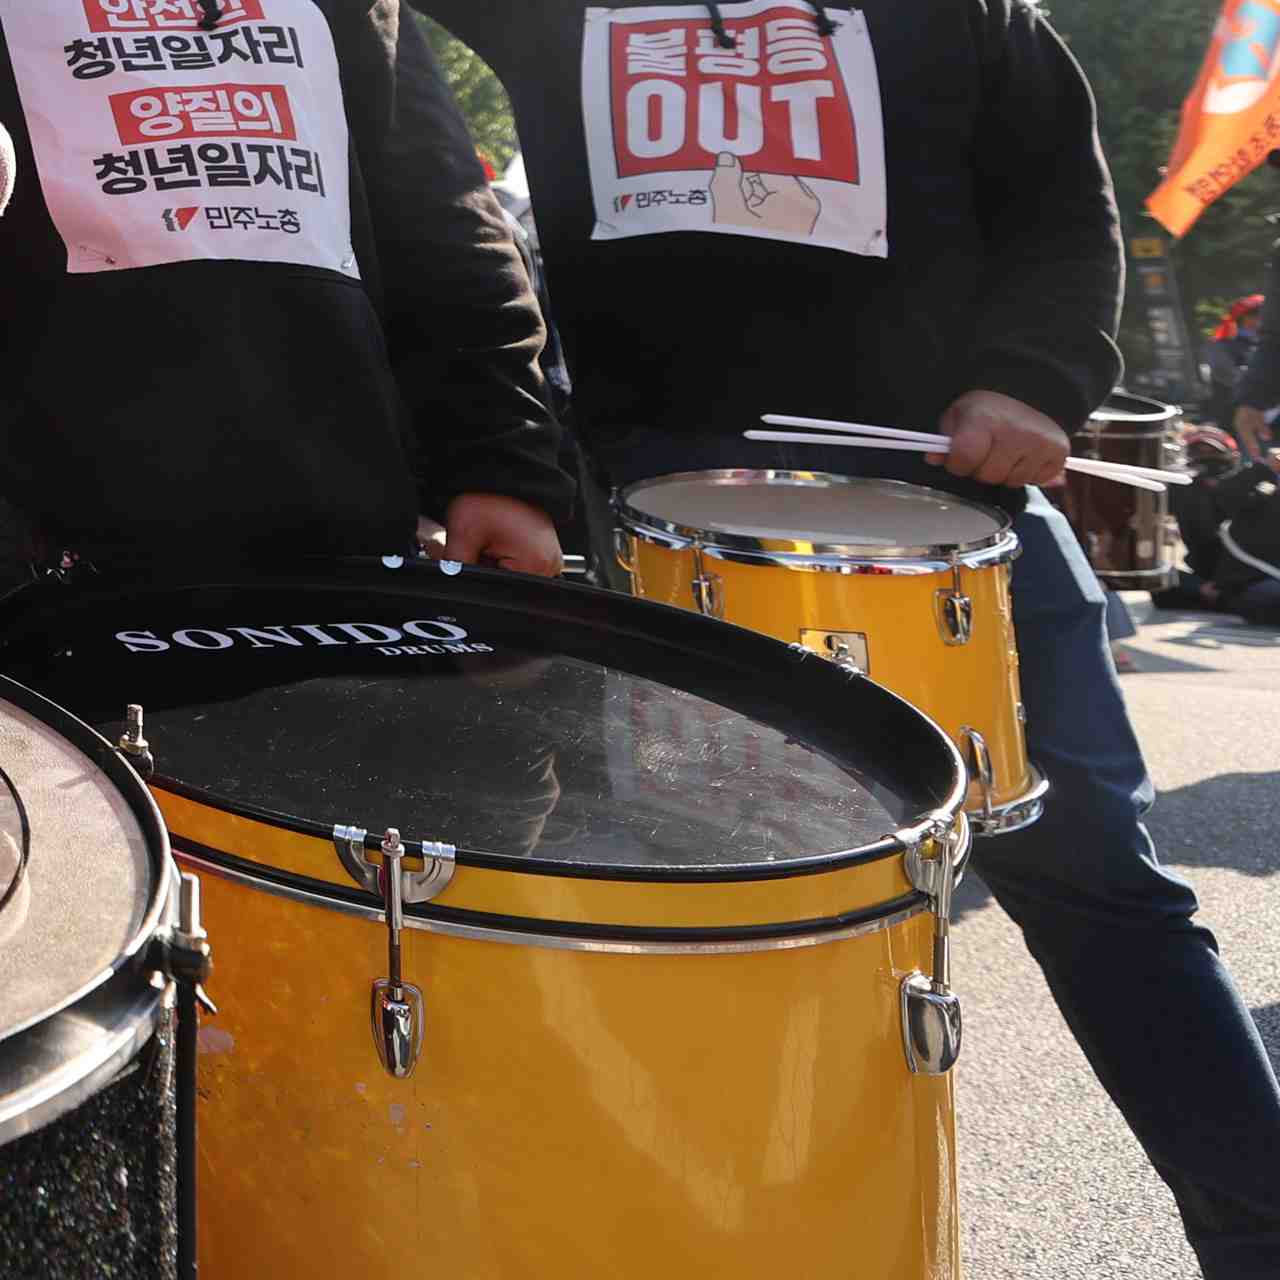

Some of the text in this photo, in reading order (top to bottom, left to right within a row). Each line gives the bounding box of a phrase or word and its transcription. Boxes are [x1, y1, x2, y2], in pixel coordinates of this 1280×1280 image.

[63, 25, 304, 80] 청년일자리
[626, 18, 827, 77] 불평등
[129, 89, 284, 137] 양질의
[626, 79, 836, 161] OUT
[93, 142, 327, 198] 청년일자리
[205, 206, 302, 234] 민주노총
[635, 189, 709, 210] 민주노총
[115, 619, 468, 653] SONIDO
[375, 641, 495, 657] DRUMS
